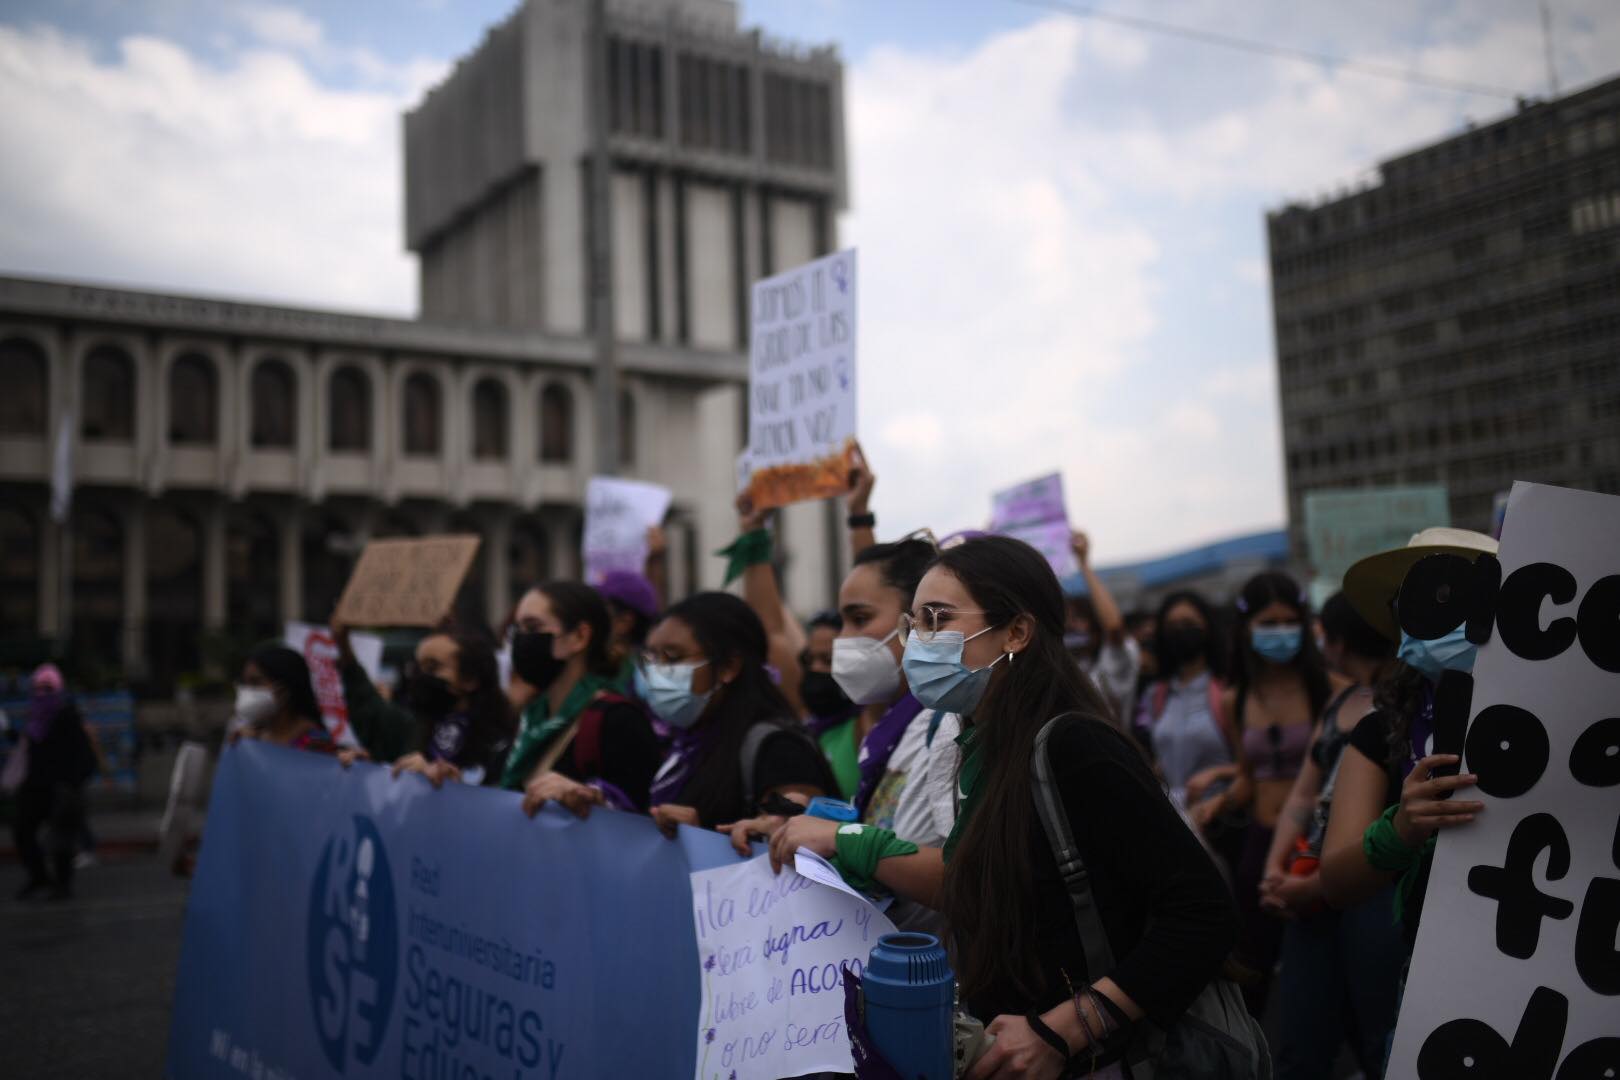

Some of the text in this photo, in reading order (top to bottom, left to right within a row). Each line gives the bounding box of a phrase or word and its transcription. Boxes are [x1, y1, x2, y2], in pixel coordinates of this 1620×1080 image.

[407, 904, 557, 990] Interuniversitaria
[763, 917, 843, 964] digna
[856, 907, 872, 942] y
[404, 943, 543, 1069] Seguras
[740, 1028, 776, 1063] no
